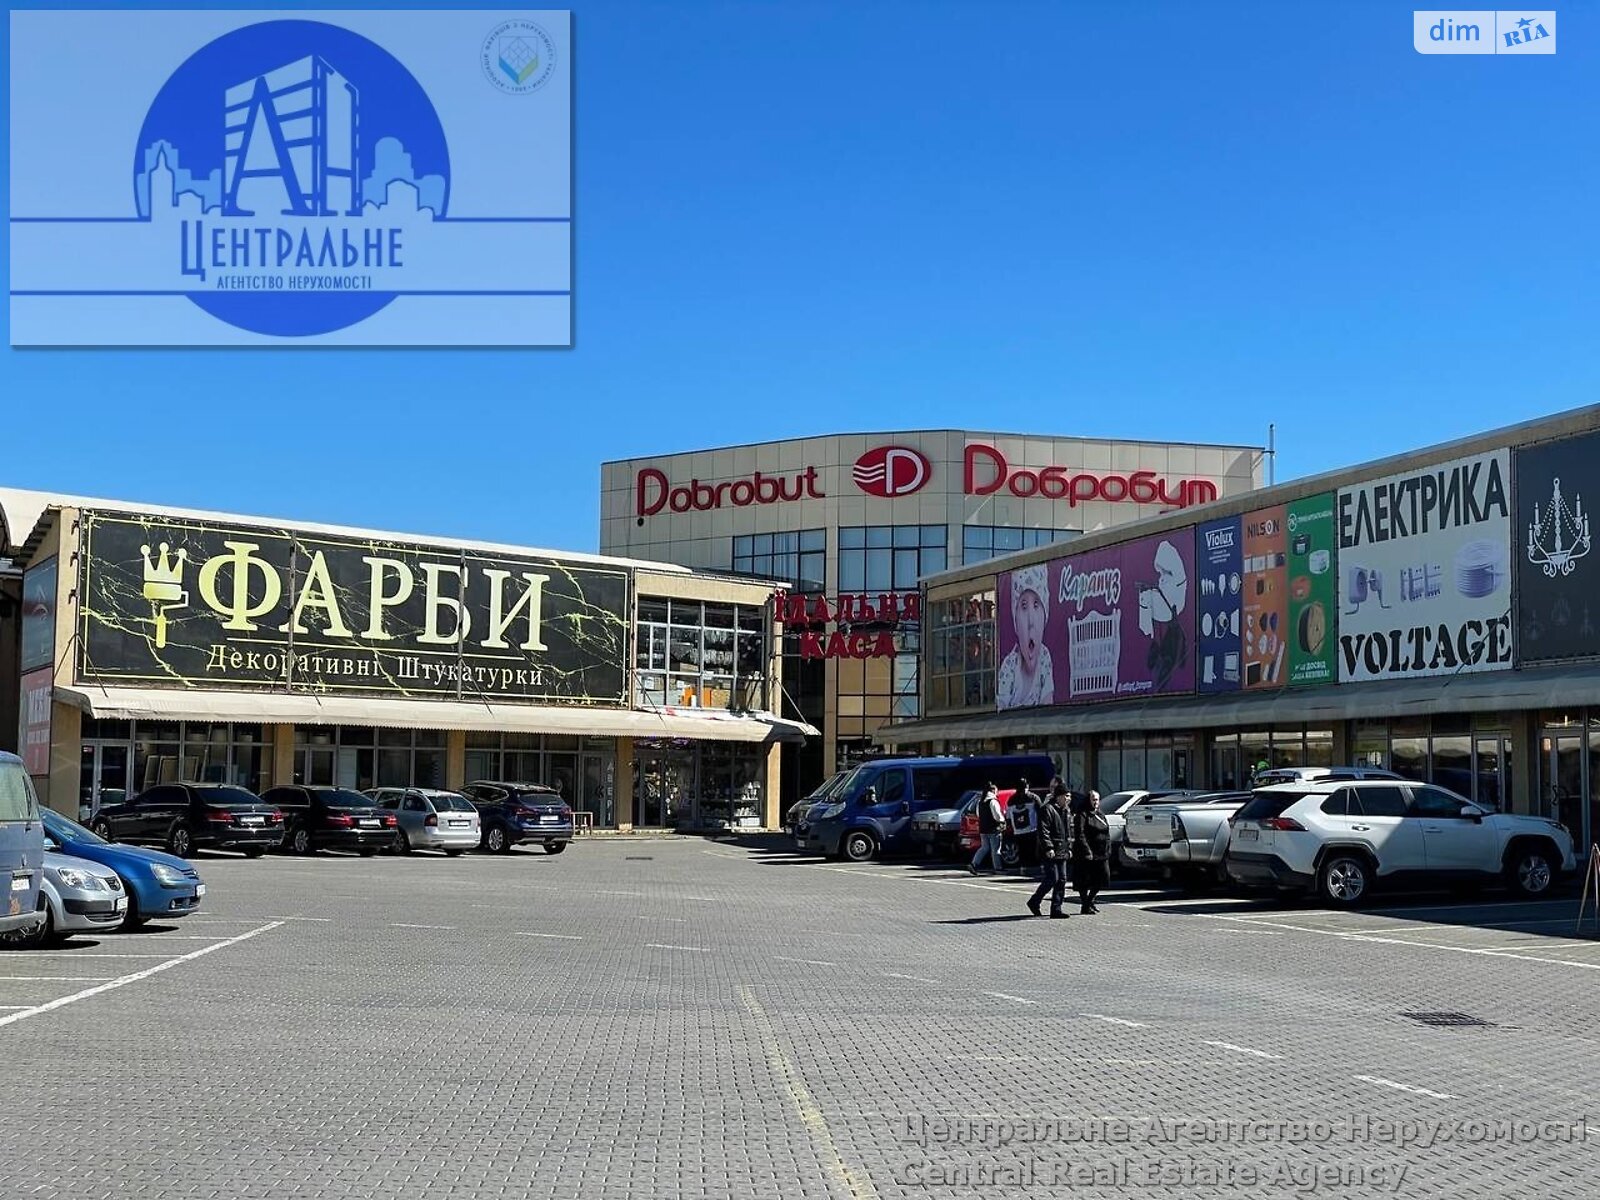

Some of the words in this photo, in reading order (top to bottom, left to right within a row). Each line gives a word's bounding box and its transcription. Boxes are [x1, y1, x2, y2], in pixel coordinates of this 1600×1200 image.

[637, 466, 826, 517] Dobrobut
[964, 444, 1217, 514] Добробут
[1339, 458, 1509, 549] ЕЛЕКТРИКА
[1205, 530, 1235, 548] Violux
[1247, 518, 1280, 538] NILSON
[198, 540, 550, 651] ФАРБИ
[1059, 564, 1121, 612] Карапуз
[206, 644, 380, 677] Декоративні
[397, 656, 543, 690] Штукатурки
[800, 629, 897, 660] КАСА
[1340, 615, 1512, 676] VOLTAGE
